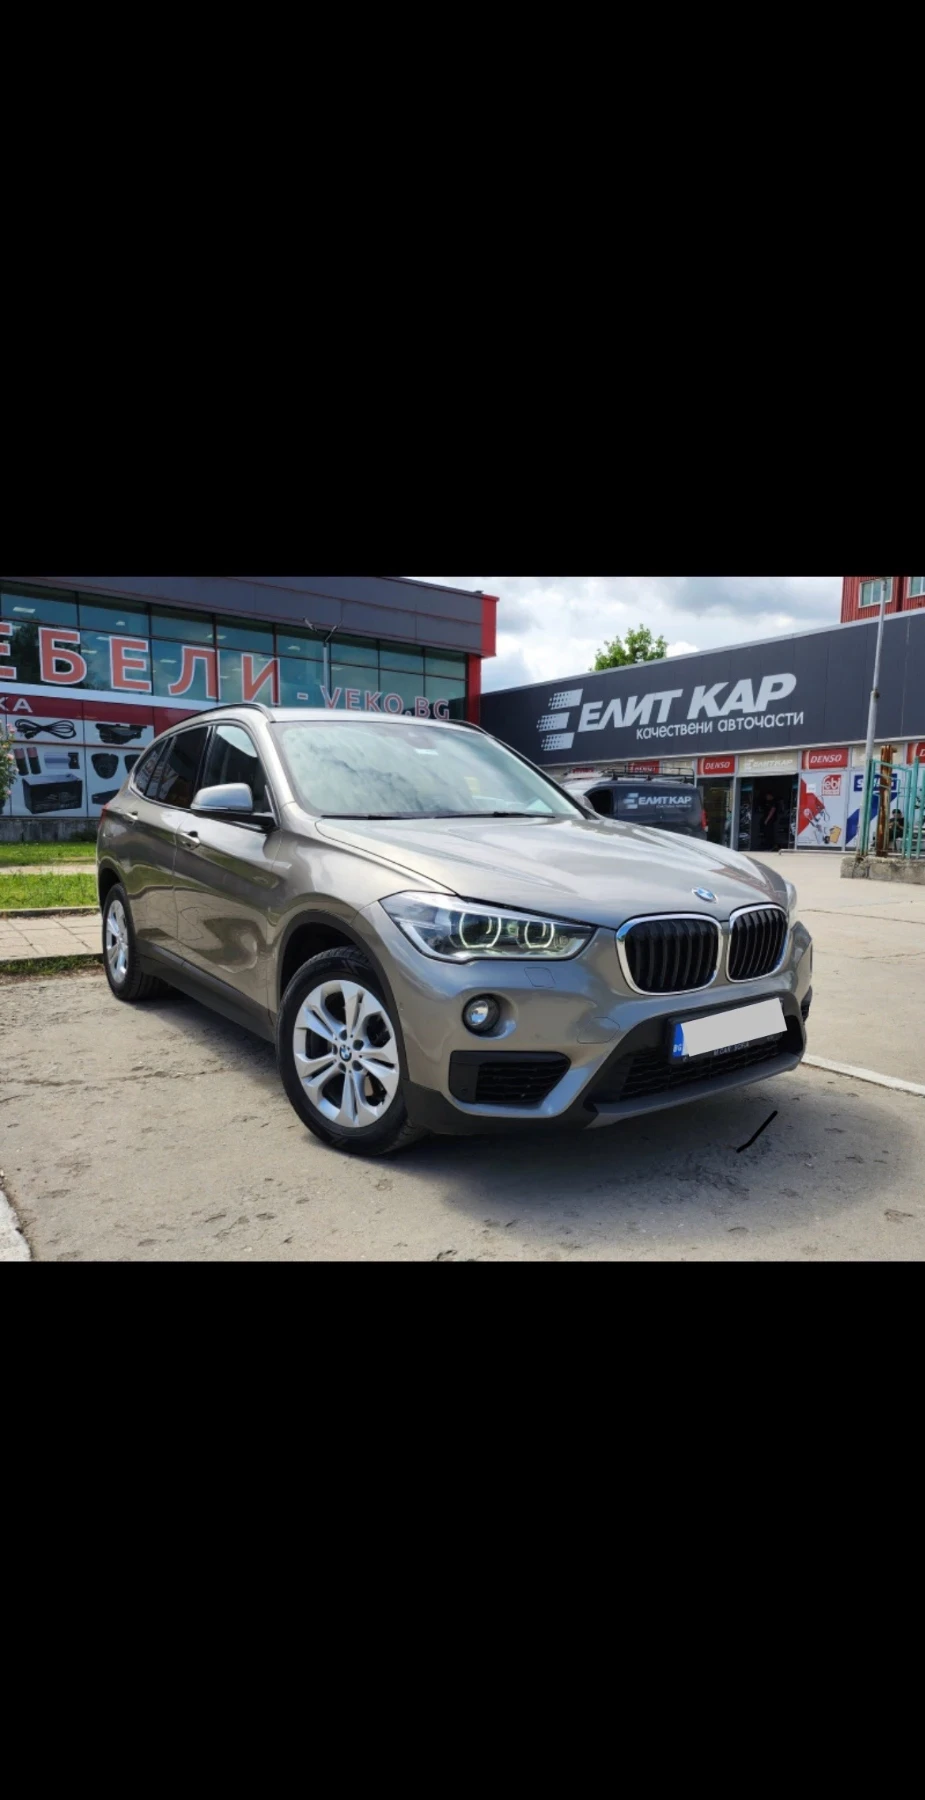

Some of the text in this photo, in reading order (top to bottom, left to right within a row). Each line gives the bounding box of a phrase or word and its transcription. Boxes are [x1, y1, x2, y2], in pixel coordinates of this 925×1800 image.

[320, 685, 450, 720] VEKO.BG
[577, 672, 797, 733] ЕЛИТ КАР
[636, 711, 805, 740] качествени авточасти
[705, 761, 731, 770] DENSO
[810, 754, 842, 764] DENSO
[669, 796, 692, 804] КАР
